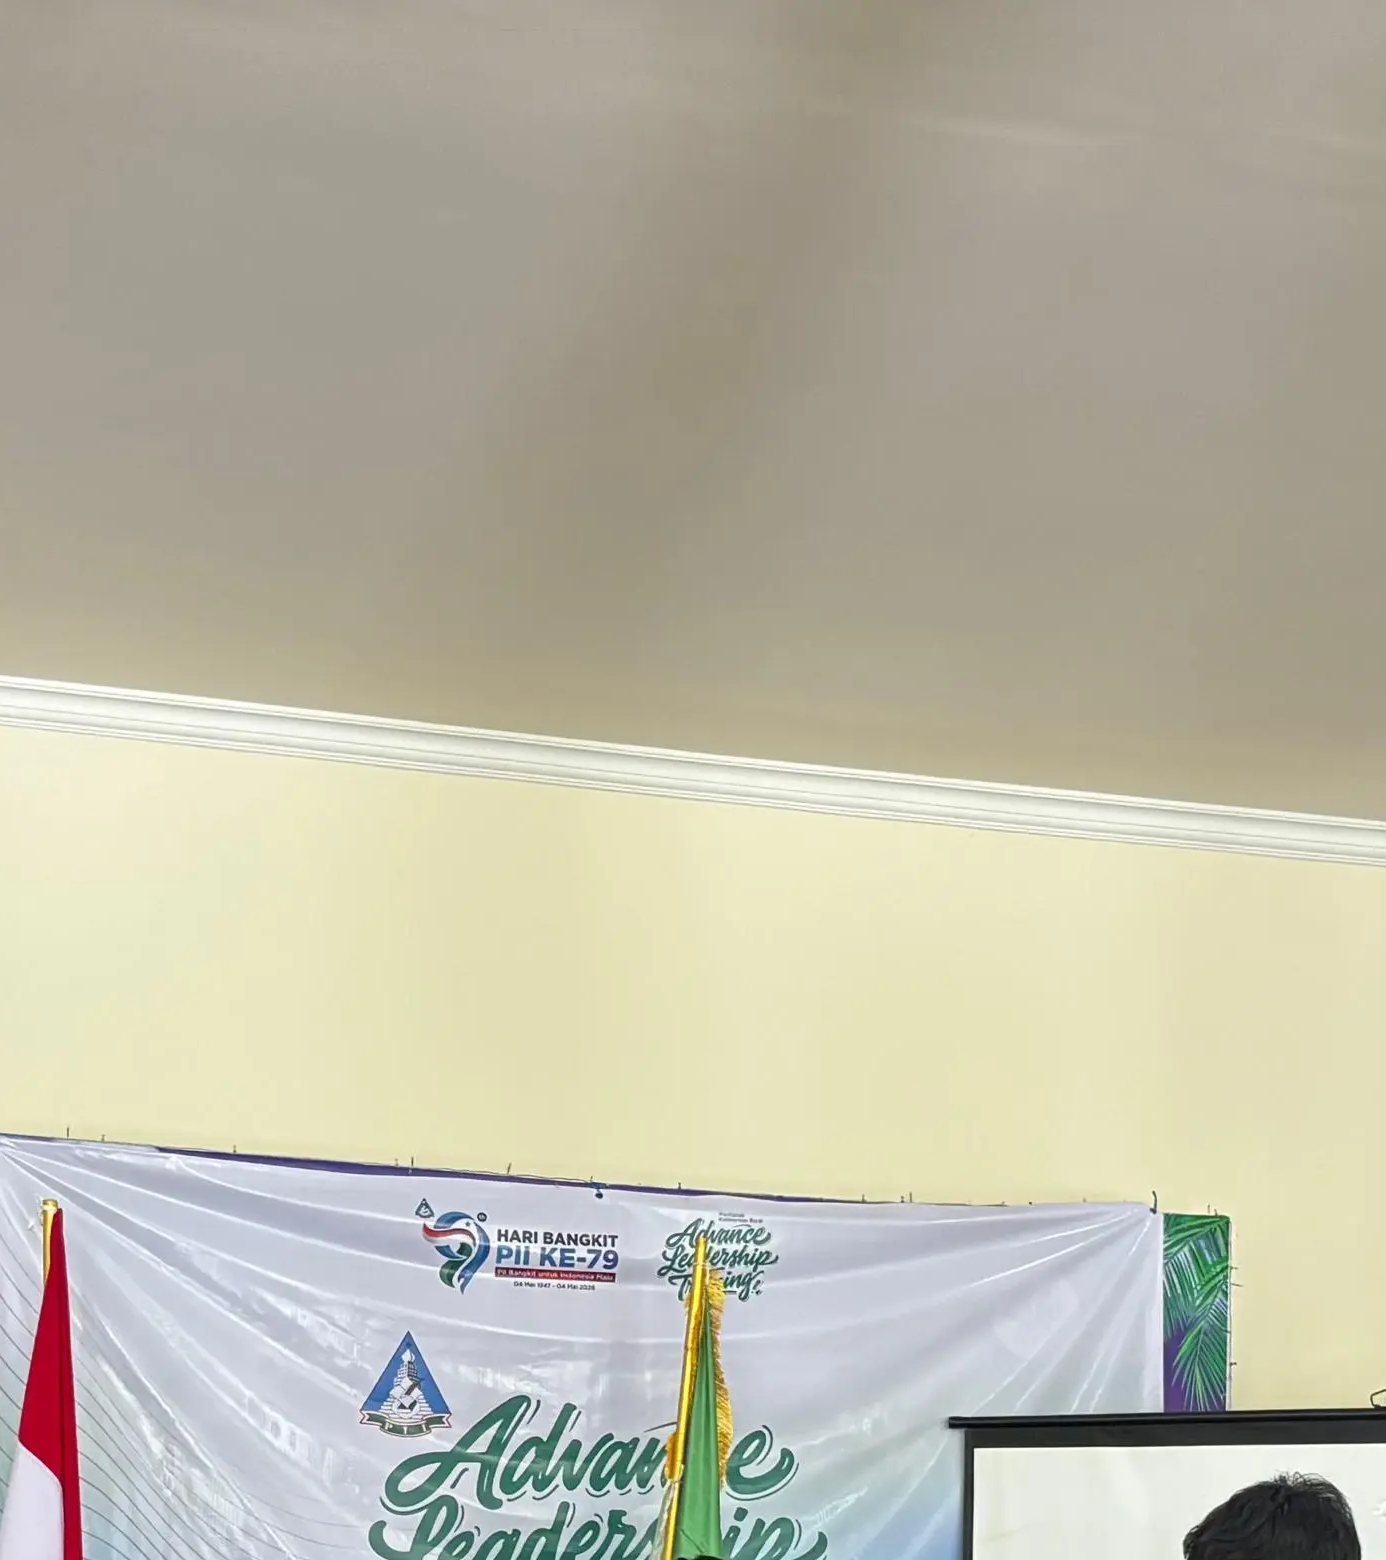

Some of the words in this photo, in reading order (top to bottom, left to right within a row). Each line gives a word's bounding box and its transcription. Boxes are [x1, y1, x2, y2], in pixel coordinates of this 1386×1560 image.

[497, 1229, 538, 1244] HARI
[543, 1231, 618, 1248] BANGKIT
[540, 1247, 619, 1270] KE-79
[384, 1394, 794, 1508] Advane
